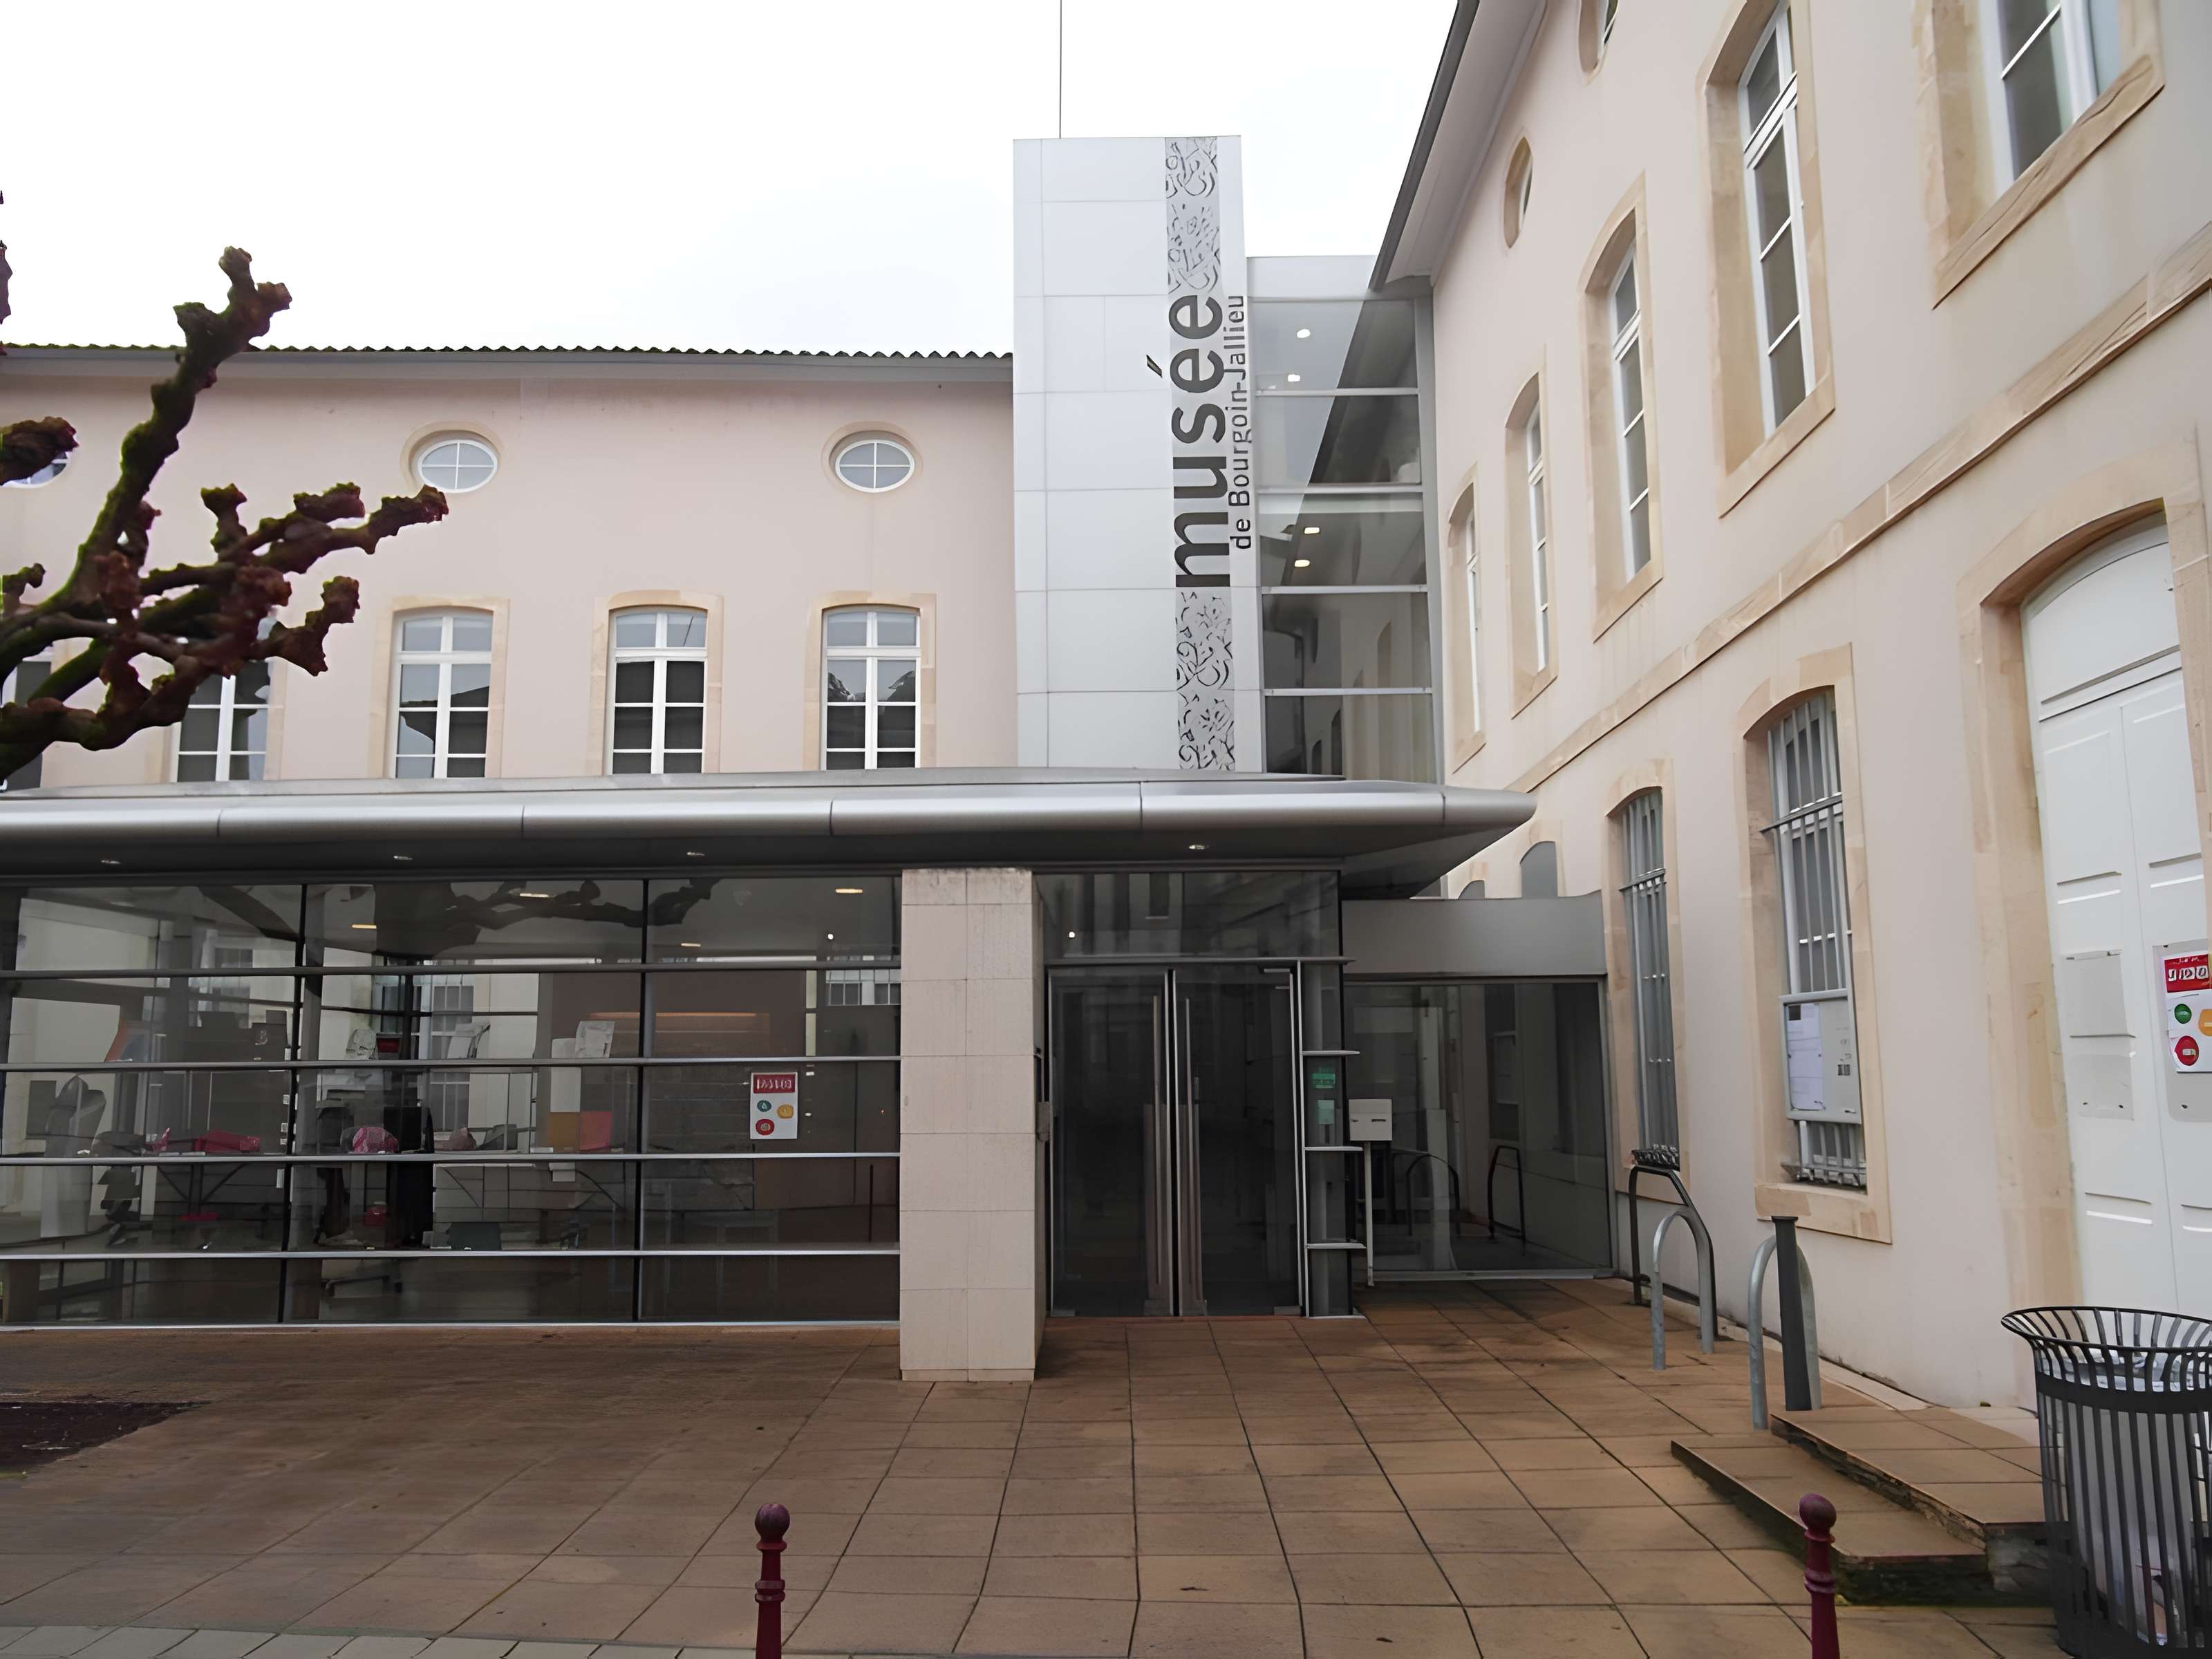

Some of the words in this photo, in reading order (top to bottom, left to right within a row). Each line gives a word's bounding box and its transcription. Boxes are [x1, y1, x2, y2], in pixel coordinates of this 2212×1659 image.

[1146, 294, 1230, 588] musée
[1224, 295, 1252, 506] Bourgoin-Jallieu
[1230, 518, 1252, 550] de
